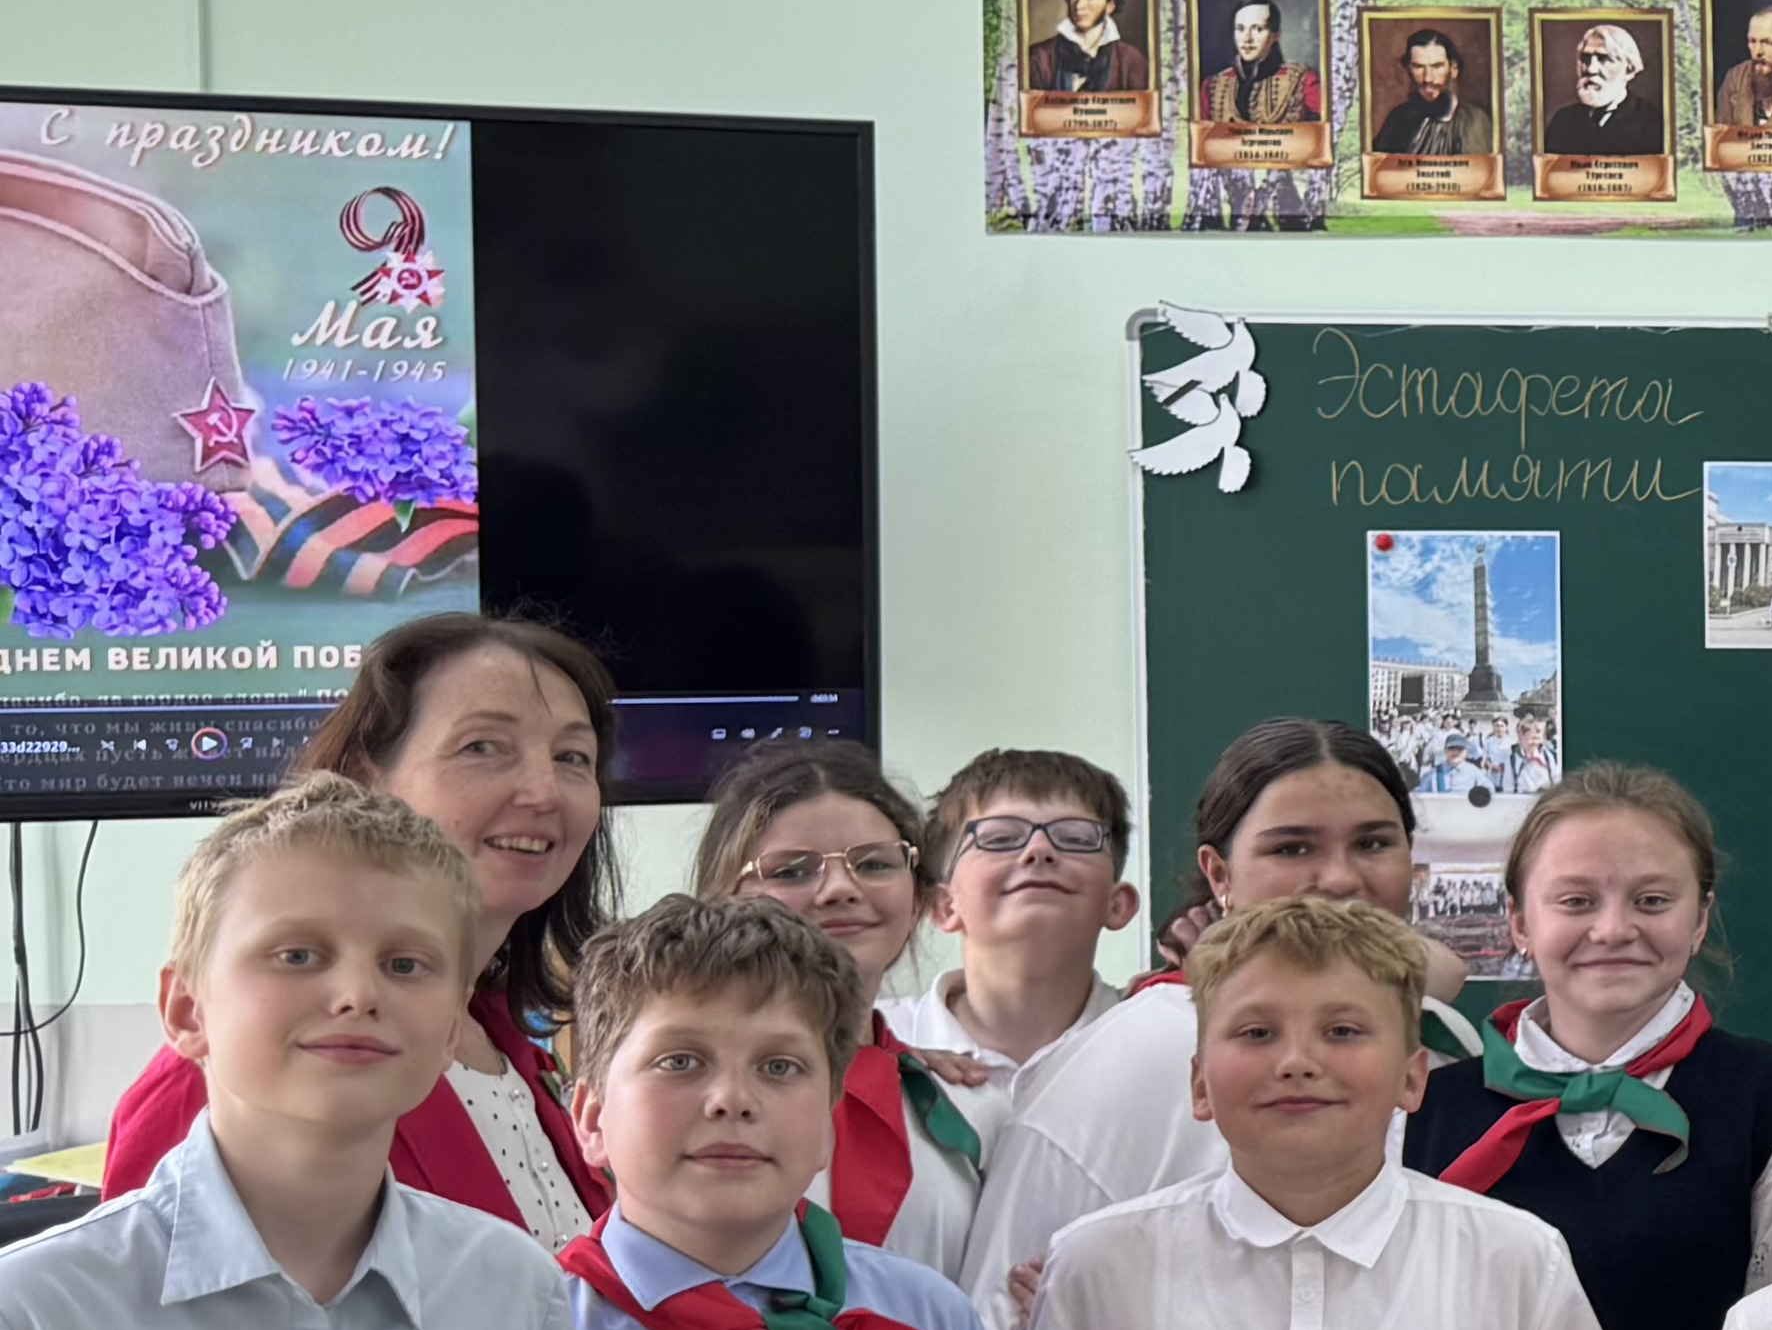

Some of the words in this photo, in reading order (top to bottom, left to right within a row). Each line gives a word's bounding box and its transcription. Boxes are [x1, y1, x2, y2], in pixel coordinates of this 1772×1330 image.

[39, 107, 74, 146] С
[105, 113, 457, 168] праздником!
[290, 299, 446, 351] Мая
[281, 357, 447, 384] 1941-1945
[1312, 326, 1705, 451] Эстафета
[1331, 453, 1702, 506] памяти
[107, 639, 278, 672] ВЕЛИКОЙ
[293, 644, 362, 669] ПОБ
